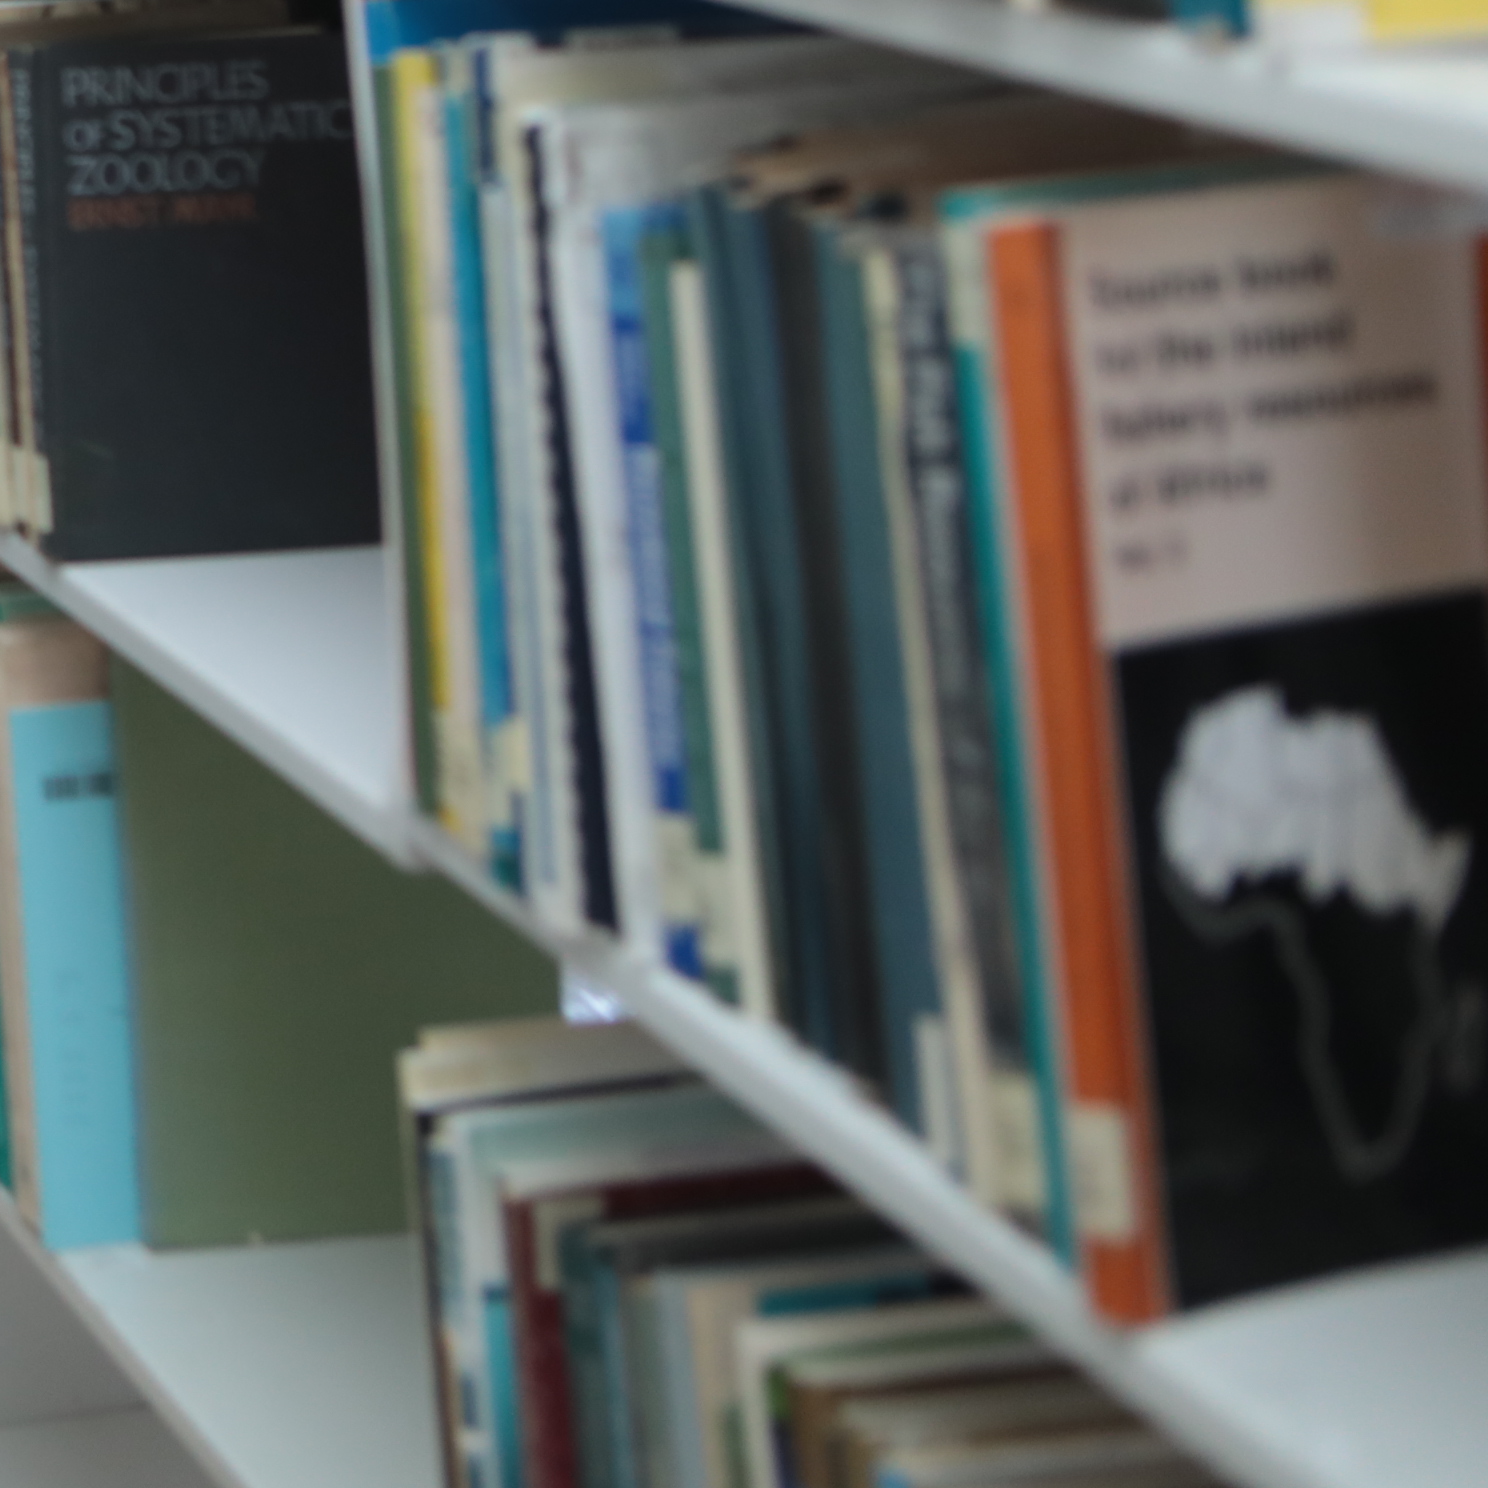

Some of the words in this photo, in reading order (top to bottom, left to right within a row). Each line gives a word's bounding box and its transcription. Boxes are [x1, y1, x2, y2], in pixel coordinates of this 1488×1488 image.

[60, 60, 270, 108] PRINCIPLES
[108, 100, 354, 151] SYSTEMATIC
[67, 146, 267, 197] ZOOLOGY
